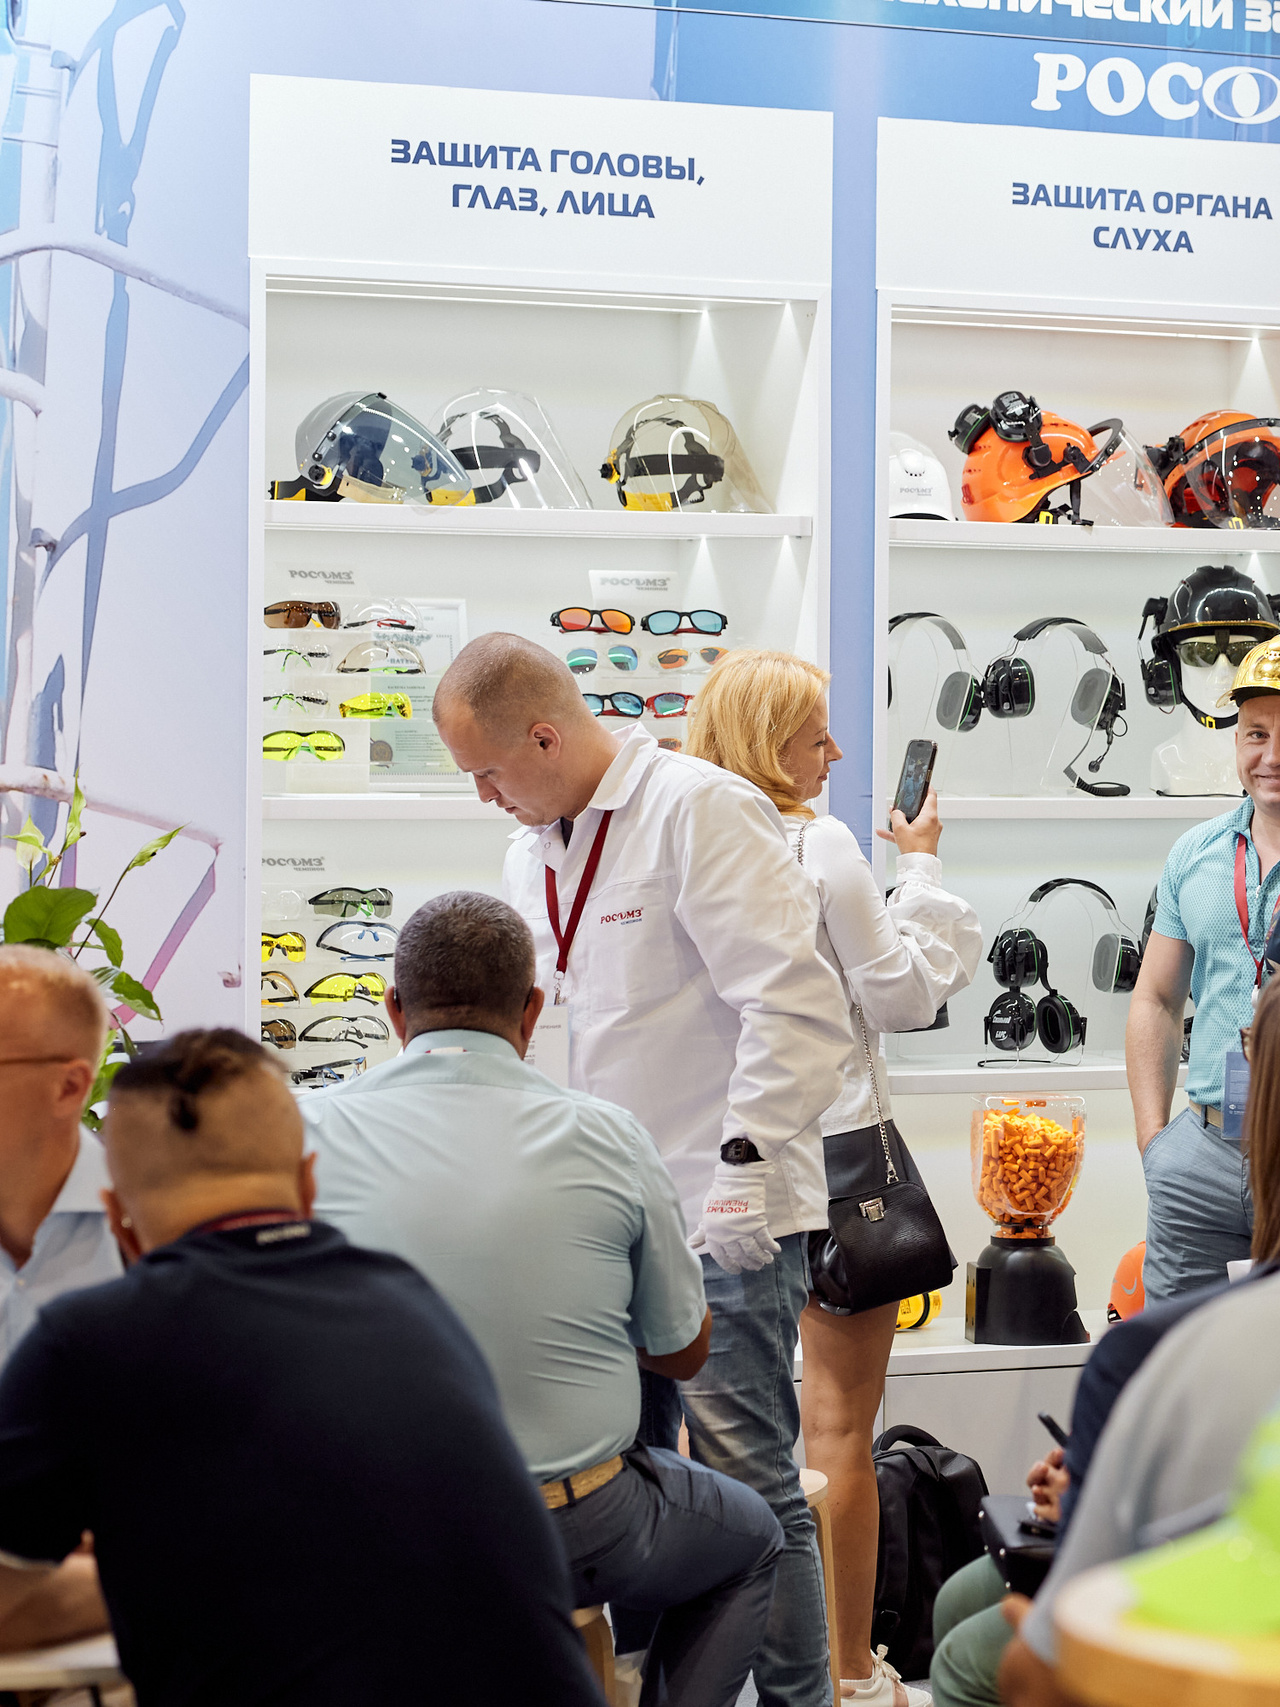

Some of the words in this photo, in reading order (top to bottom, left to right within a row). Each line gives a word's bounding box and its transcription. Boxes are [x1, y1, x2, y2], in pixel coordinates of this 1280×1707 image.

[391, 139, 542, 172] ЗАЩИТА
[550, 149, 705, 185] ГОЛОВЫ,
[452, 183, 548, 217] ГЛАЗ,
[556, 190, 656, 218] ЛИЦА
[1012, 182, 1146, 213] ЗАЩИТА
[1153, 191, 1273, 220] ОРГАНА
[1093, 225, 1195, 253] СЛУХА
